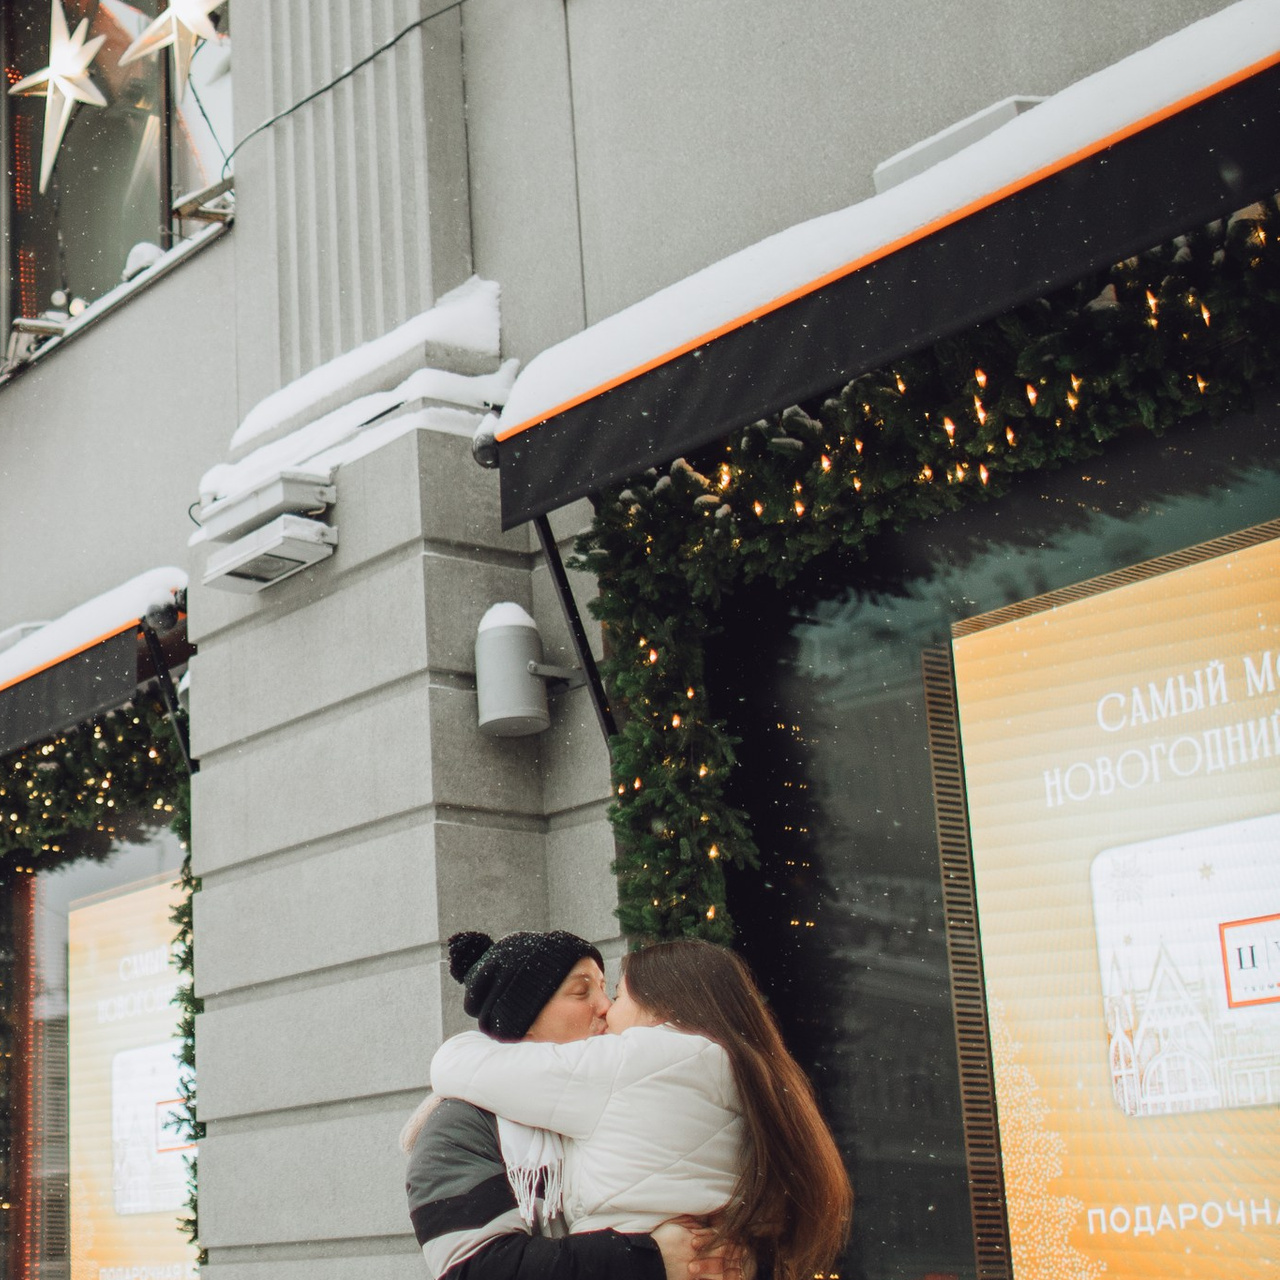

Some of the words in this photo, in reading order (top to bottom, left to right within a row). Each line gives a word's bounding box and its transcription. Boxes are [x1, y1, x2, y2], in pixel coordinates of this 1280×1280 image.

[1095, 658, 1229, 733] САМЫЙ
[1243, 650, 1280, 697] М
[1087, 1198, 1280, 1237] ПОДАРОЧН
